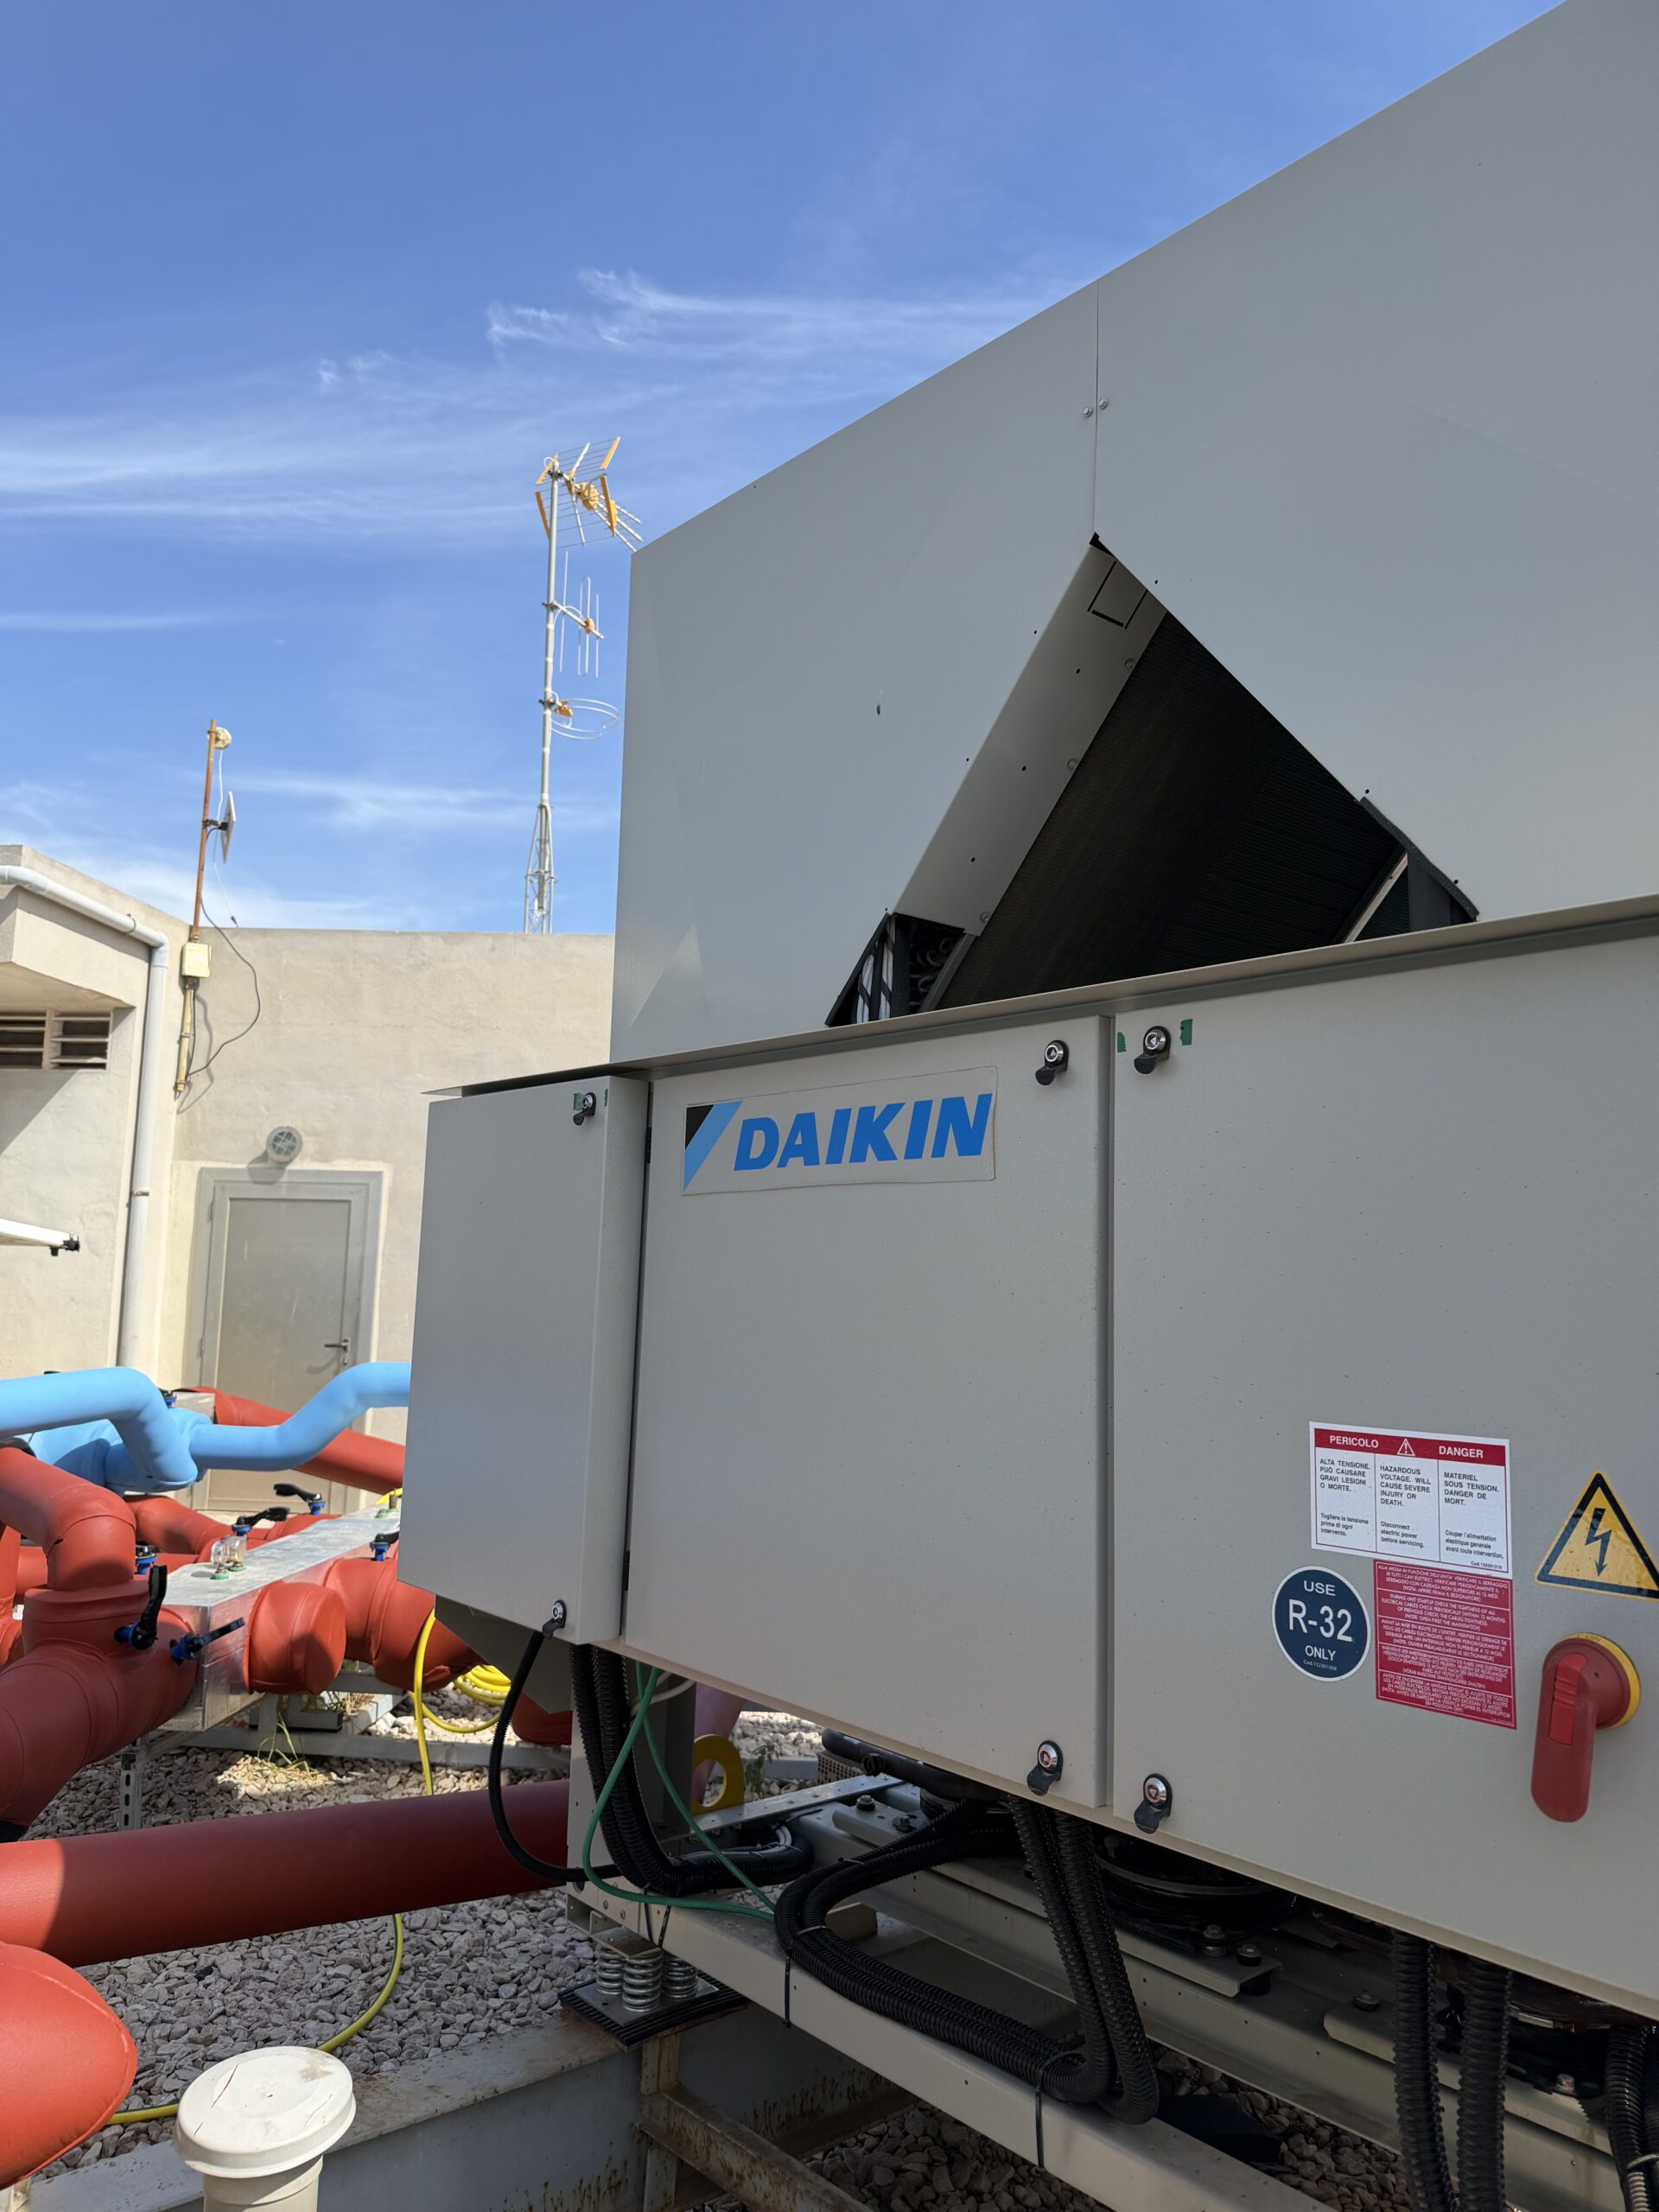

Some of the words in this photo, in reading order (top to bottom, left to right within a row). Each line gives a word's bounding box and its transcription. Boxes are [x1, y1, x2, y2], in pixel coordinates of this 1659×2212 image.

[734, 1093, 993, 1171] DAIKIN
[1329, 1436, 1378, 1448] PERICOLO
[1439, 1446, 1483, 1458] DANGER
[1337, 1460, 1370, 1469] TENSIONE.
[1336, 1468, 1365, 1477] CAUSARE
[1380, 1465, 1420, 1475] HAZARDOUS
[1380, 1473, 1411, 1482] VOLTAGE.
[1444, 1471, 1477, 1481] MATERIEL
[1341, 1477, 1365, 1485] LESIONI
[1328, 1483, 1351, 1491] MORTE.
[1380, 1481, 1402, 1489] CAUSE
[1404, 1484, 1430, 1493] SEVERE
[1467, 1482, 1498, 1492] TENSION.
[1380, 1489, 1403, 1498] INJURY
[1444, 1489, 1473, 1498] DANGER
[1380, 1498, 1403, 1506] DEATH.
[1444, 1497, 1465, 1505] MORT.
[1320, 1512, 1340, 1521] Togliere
[1381, 1521, 1409, 1530] Disconnect
[1445, 1529, 1462, 1537] Couper
[1398, 1538, 1424, 1548] servicing.
[1473, 1549, 1503, 1558] intervention.
[1304, 1580, 1336, 1596] USE
[1289, 1599, 1352, 1642] R-32
[1305, 1645, 1336, 1661] ONLY
